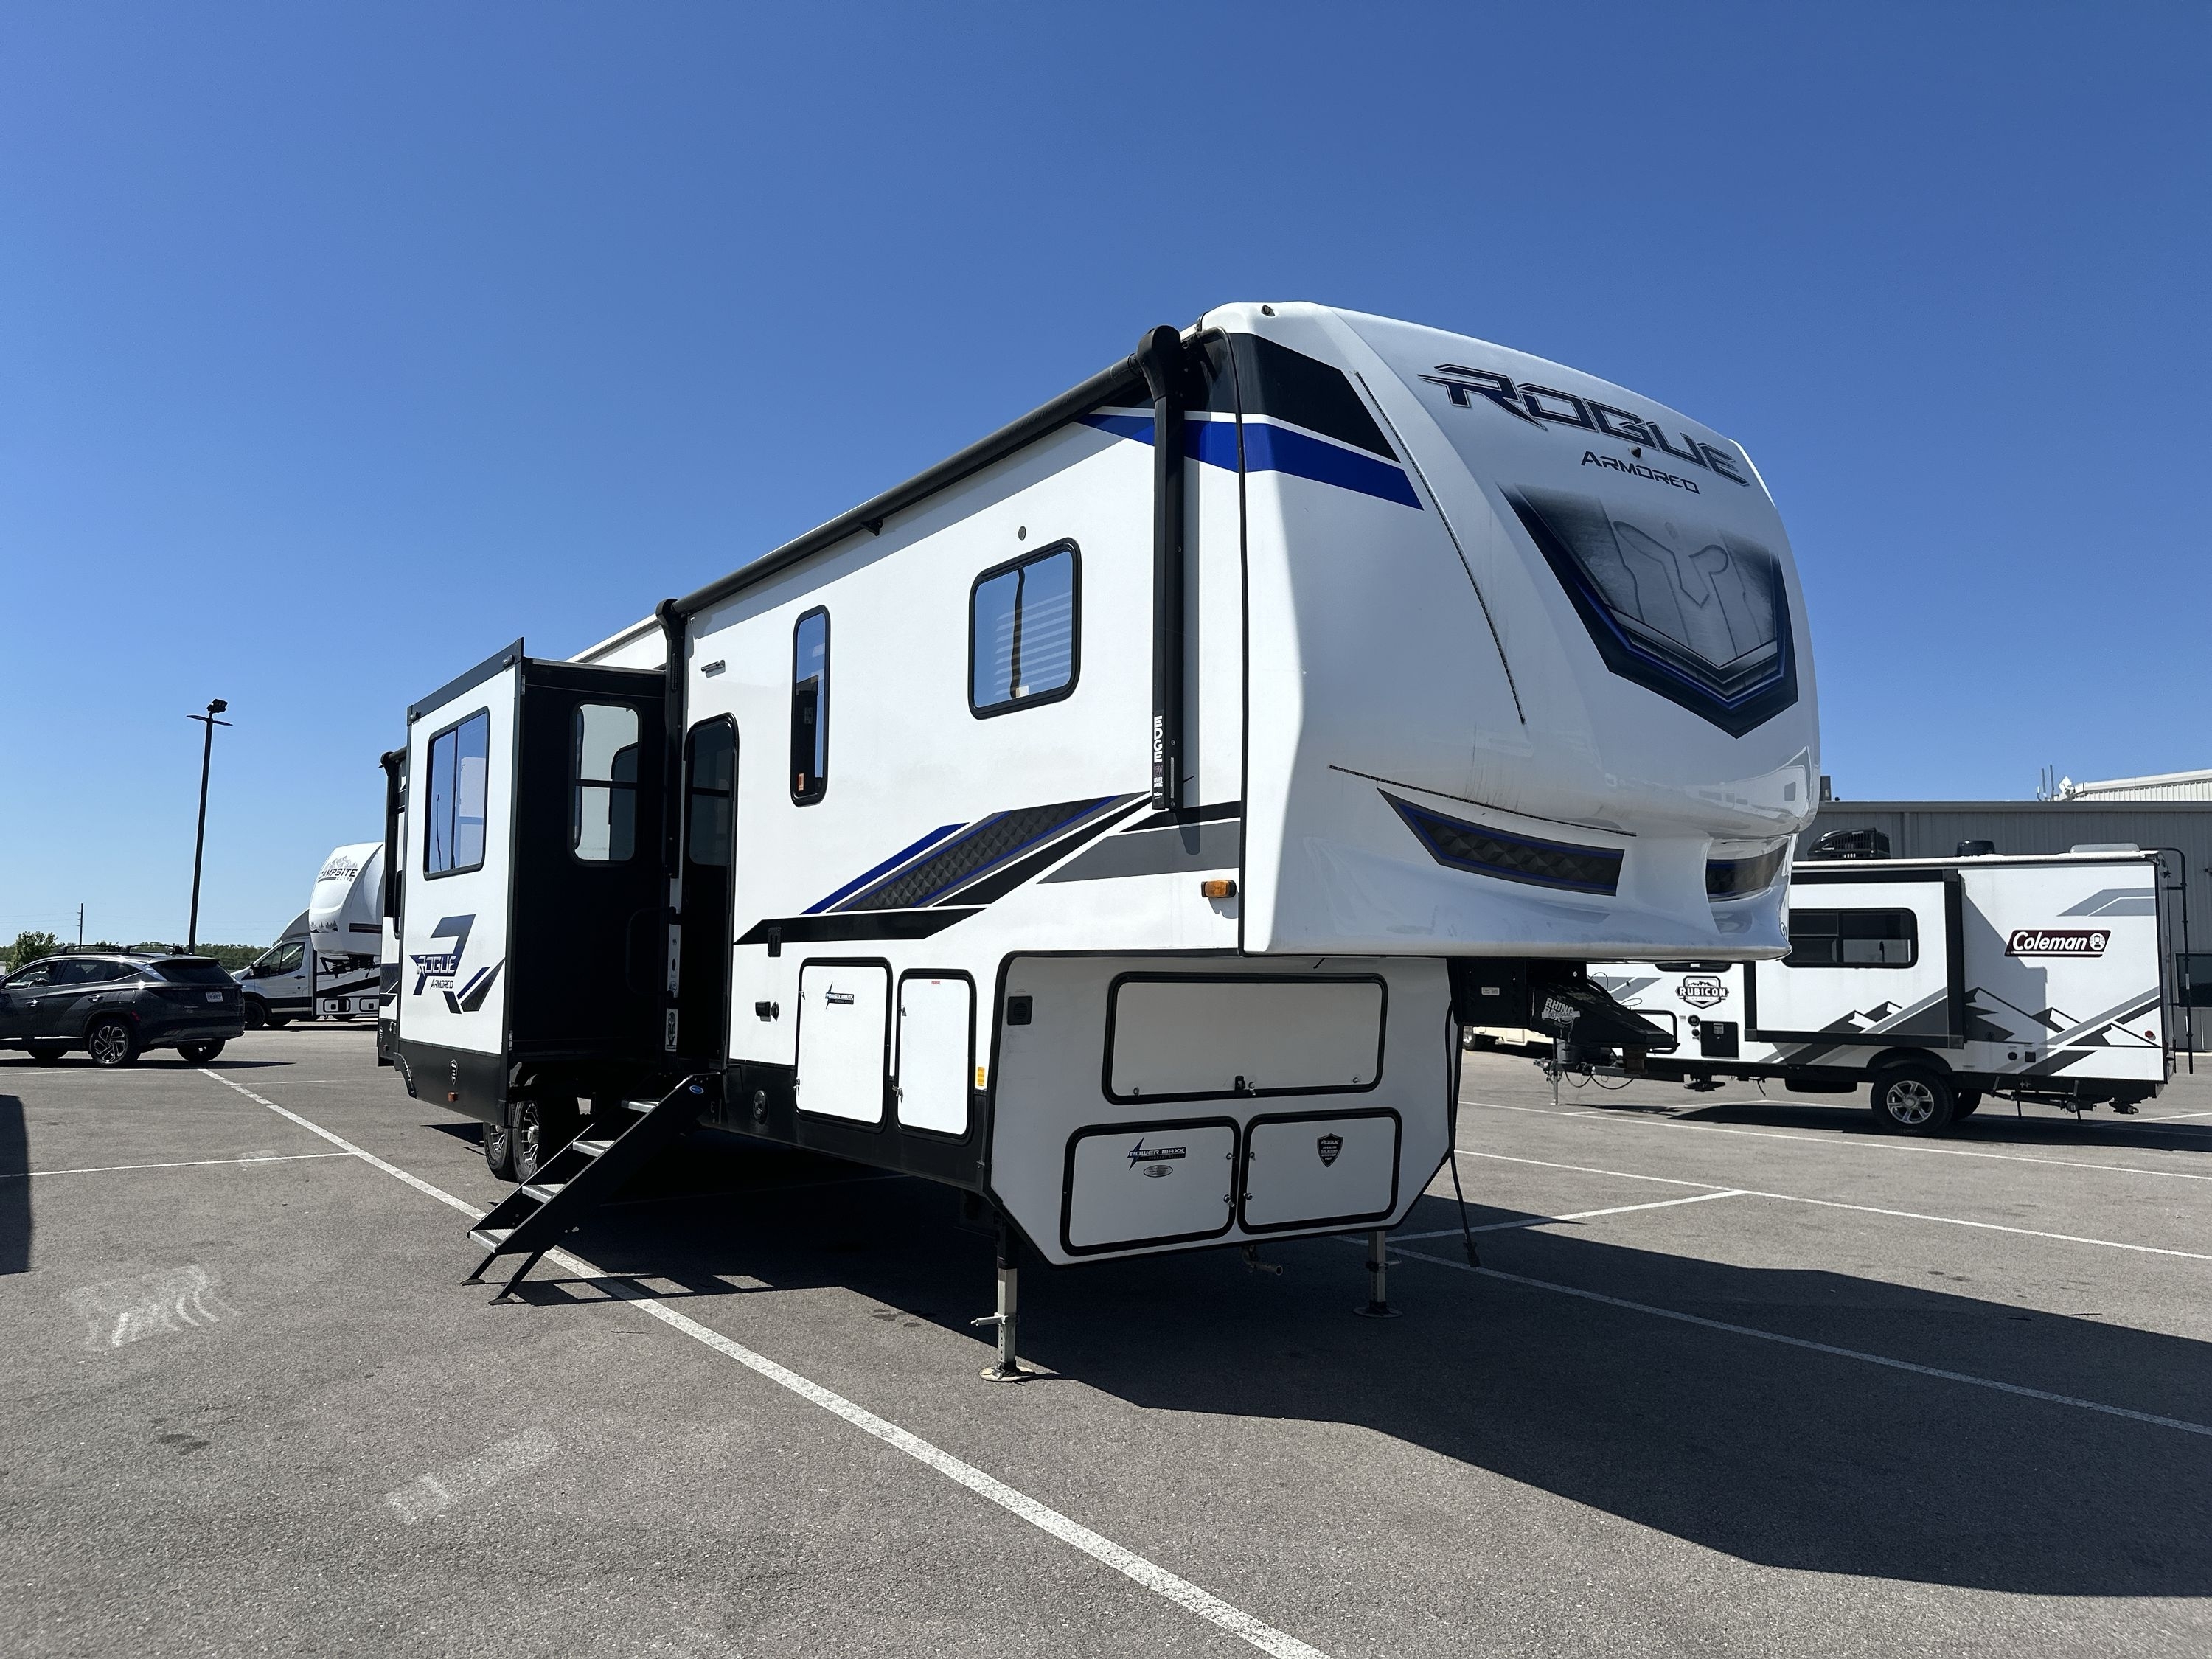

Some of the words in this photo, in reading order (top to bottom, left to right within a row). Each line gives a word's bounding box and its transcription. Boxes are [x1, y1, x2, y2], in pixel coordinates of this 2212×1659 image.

[1417, 364, 1750, 486] ROGUE
[1580, 451, 1700, 495] ARMORED
[1154, 715, 1163, 763] EDGE
[2013, 931, 2087, 950] Coleman
[415, 955, 456, 978] ROGUE
[430, 978, 454, 990] ARMORED
[1679, 987, 1726, 997] RUBICON
[1545, 997, 1574, 1016] RHINO
